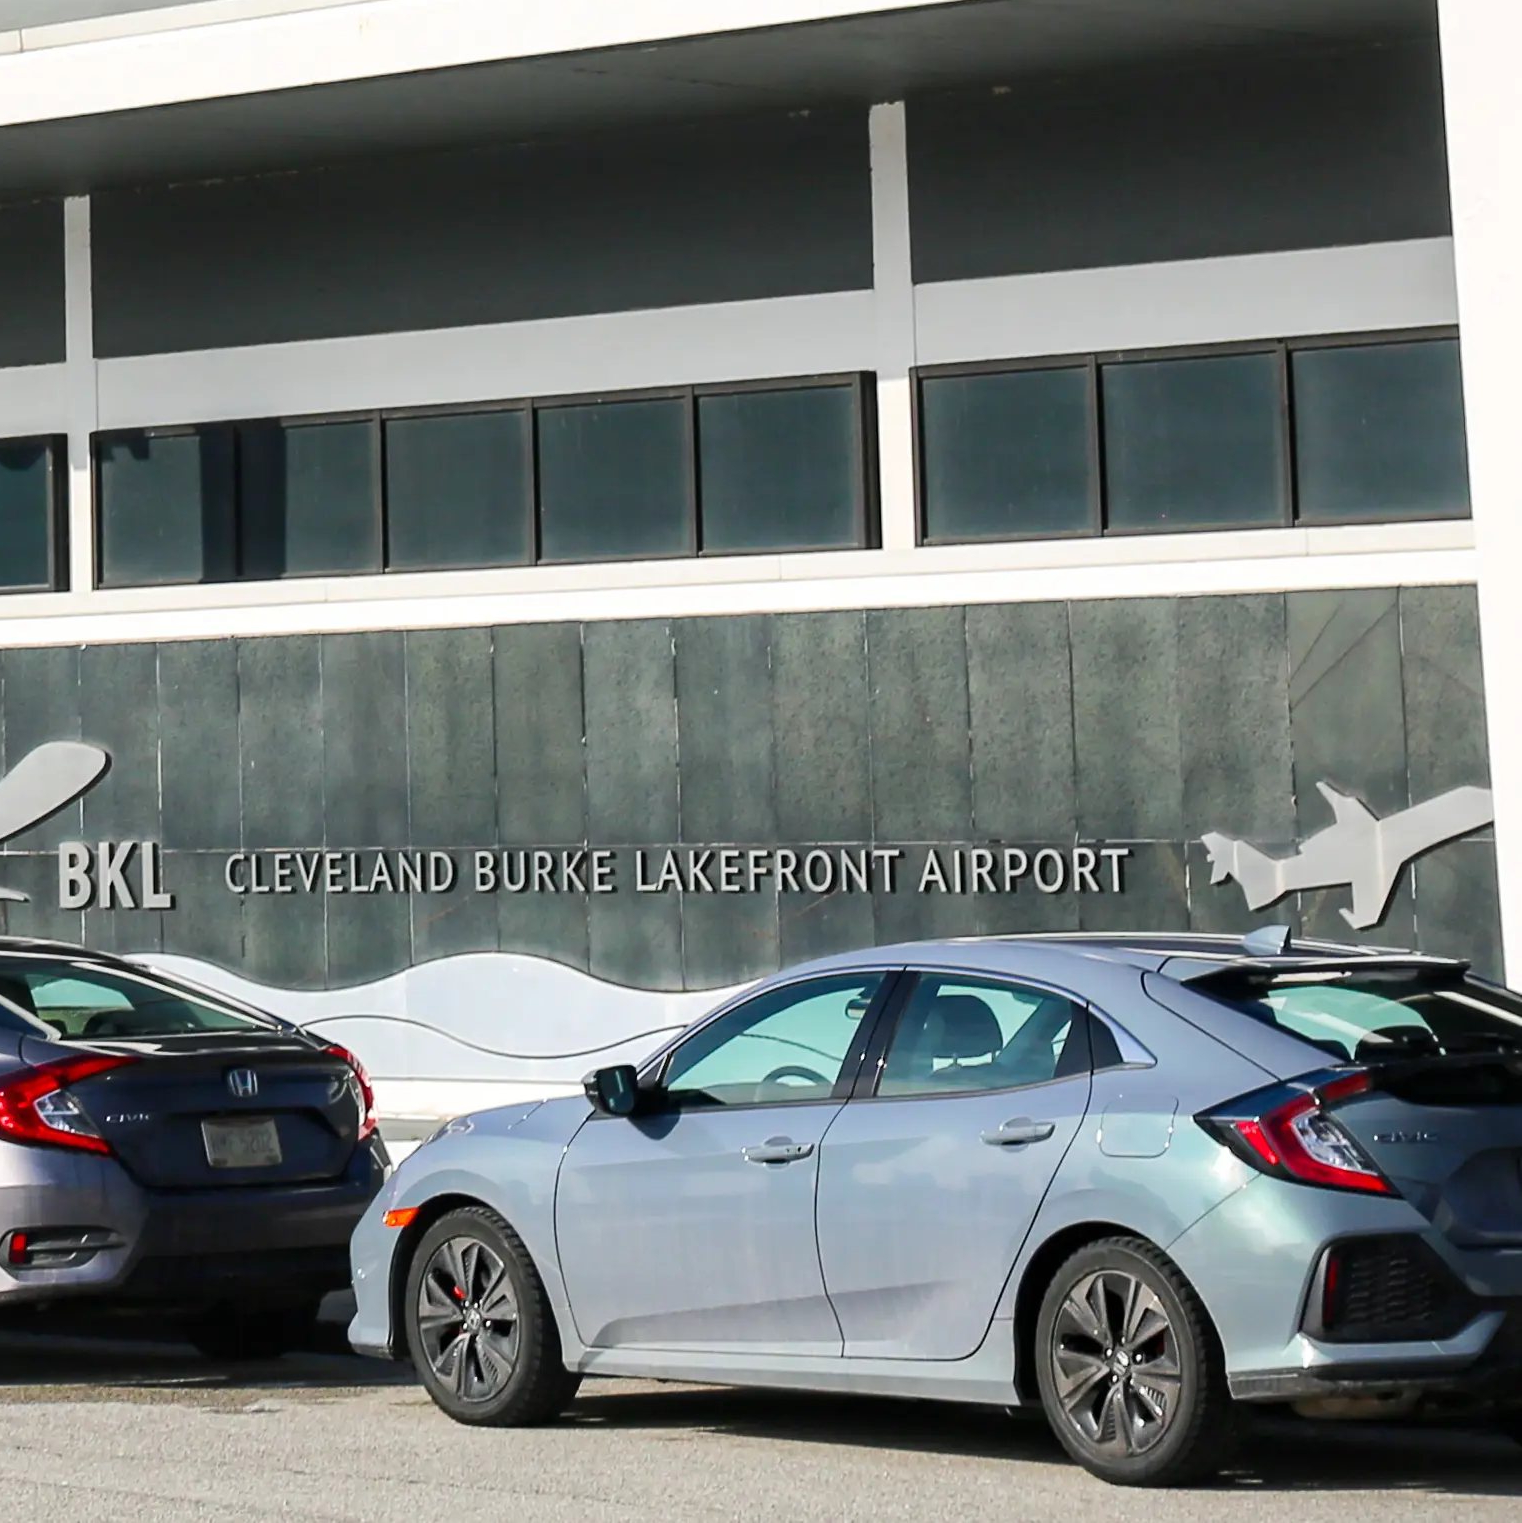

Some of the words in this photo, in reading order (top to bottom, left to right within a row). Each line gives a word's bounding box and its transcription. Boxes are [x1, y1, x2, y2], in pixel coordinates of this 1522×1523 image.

[58, 841, 172, 910] BKL
[224, 851, 455, 894] CLEVELAND
[474, 850, 616, 893] BURKE
[635, 849, 901, 893] LAKEFRONT
[918, 848, 1131, 893] AIRPORT
